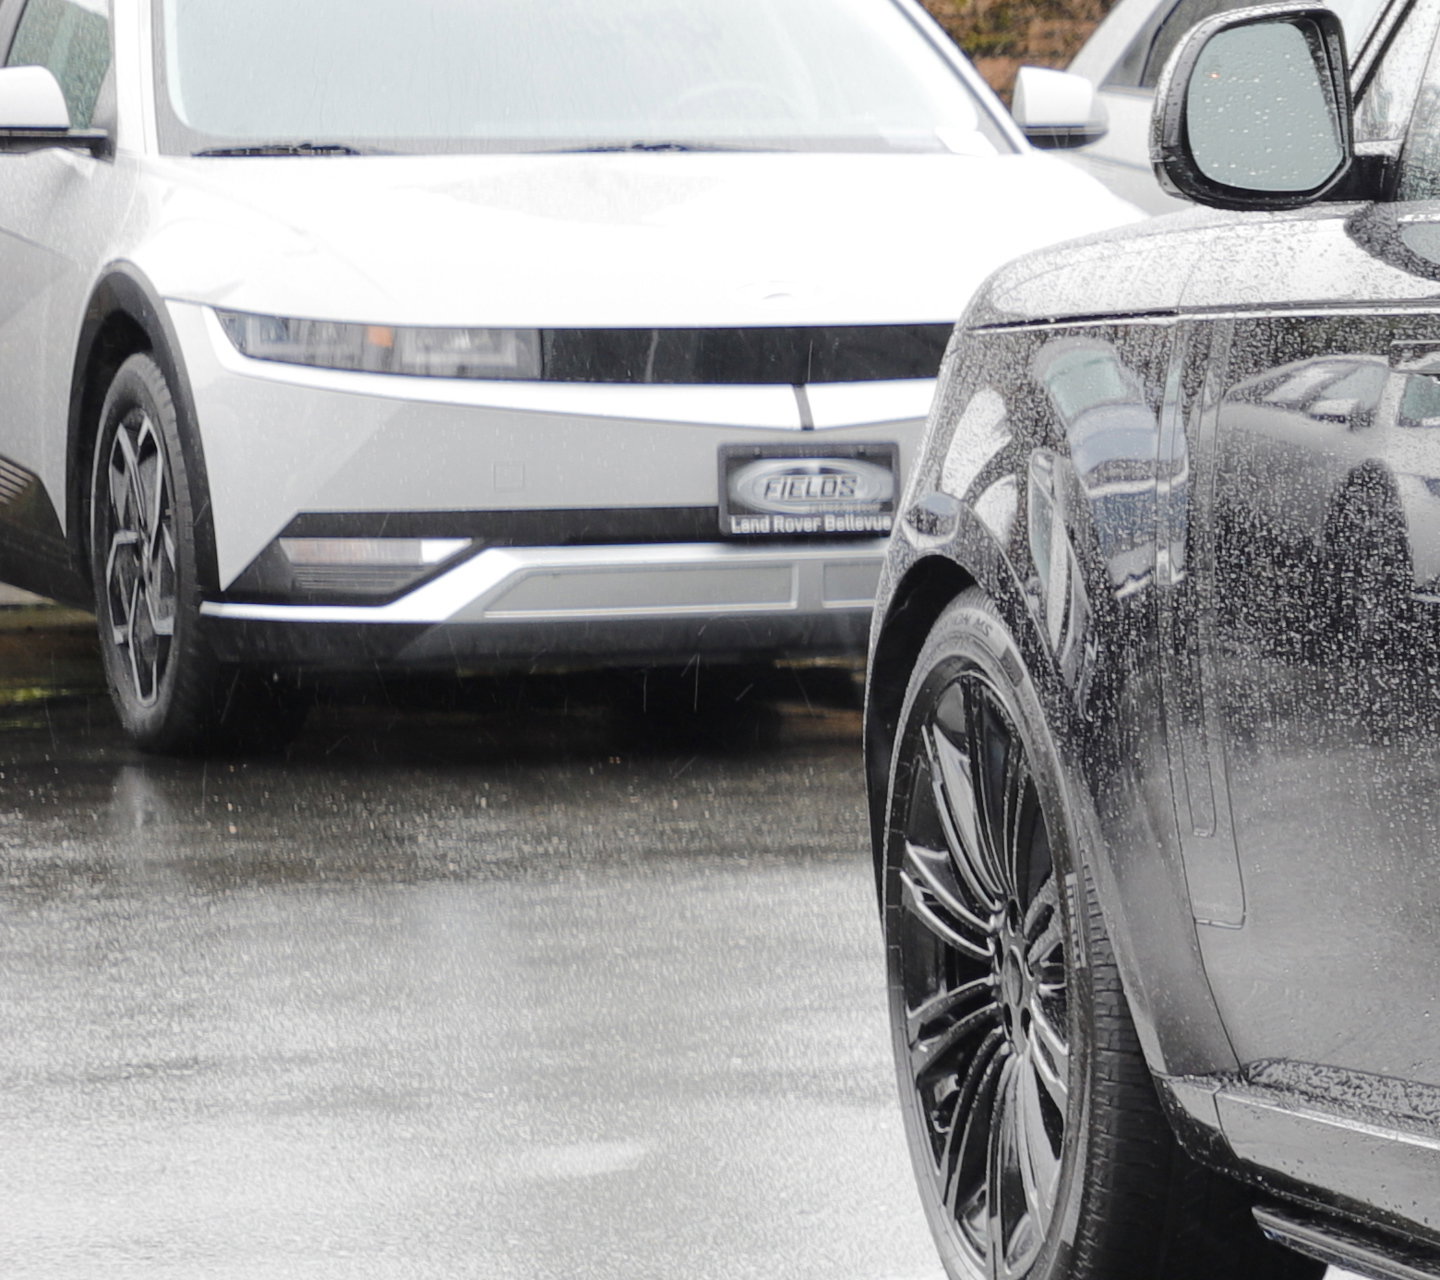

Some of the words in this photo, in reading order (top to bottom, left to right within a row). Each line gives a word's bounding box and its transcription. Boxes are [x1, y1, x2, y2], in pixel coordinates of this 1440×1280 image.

[730, 516, 770, 535] Land
[774, 515, 821, 533] Rover
[824, 514, 892, 532] Bellevue
